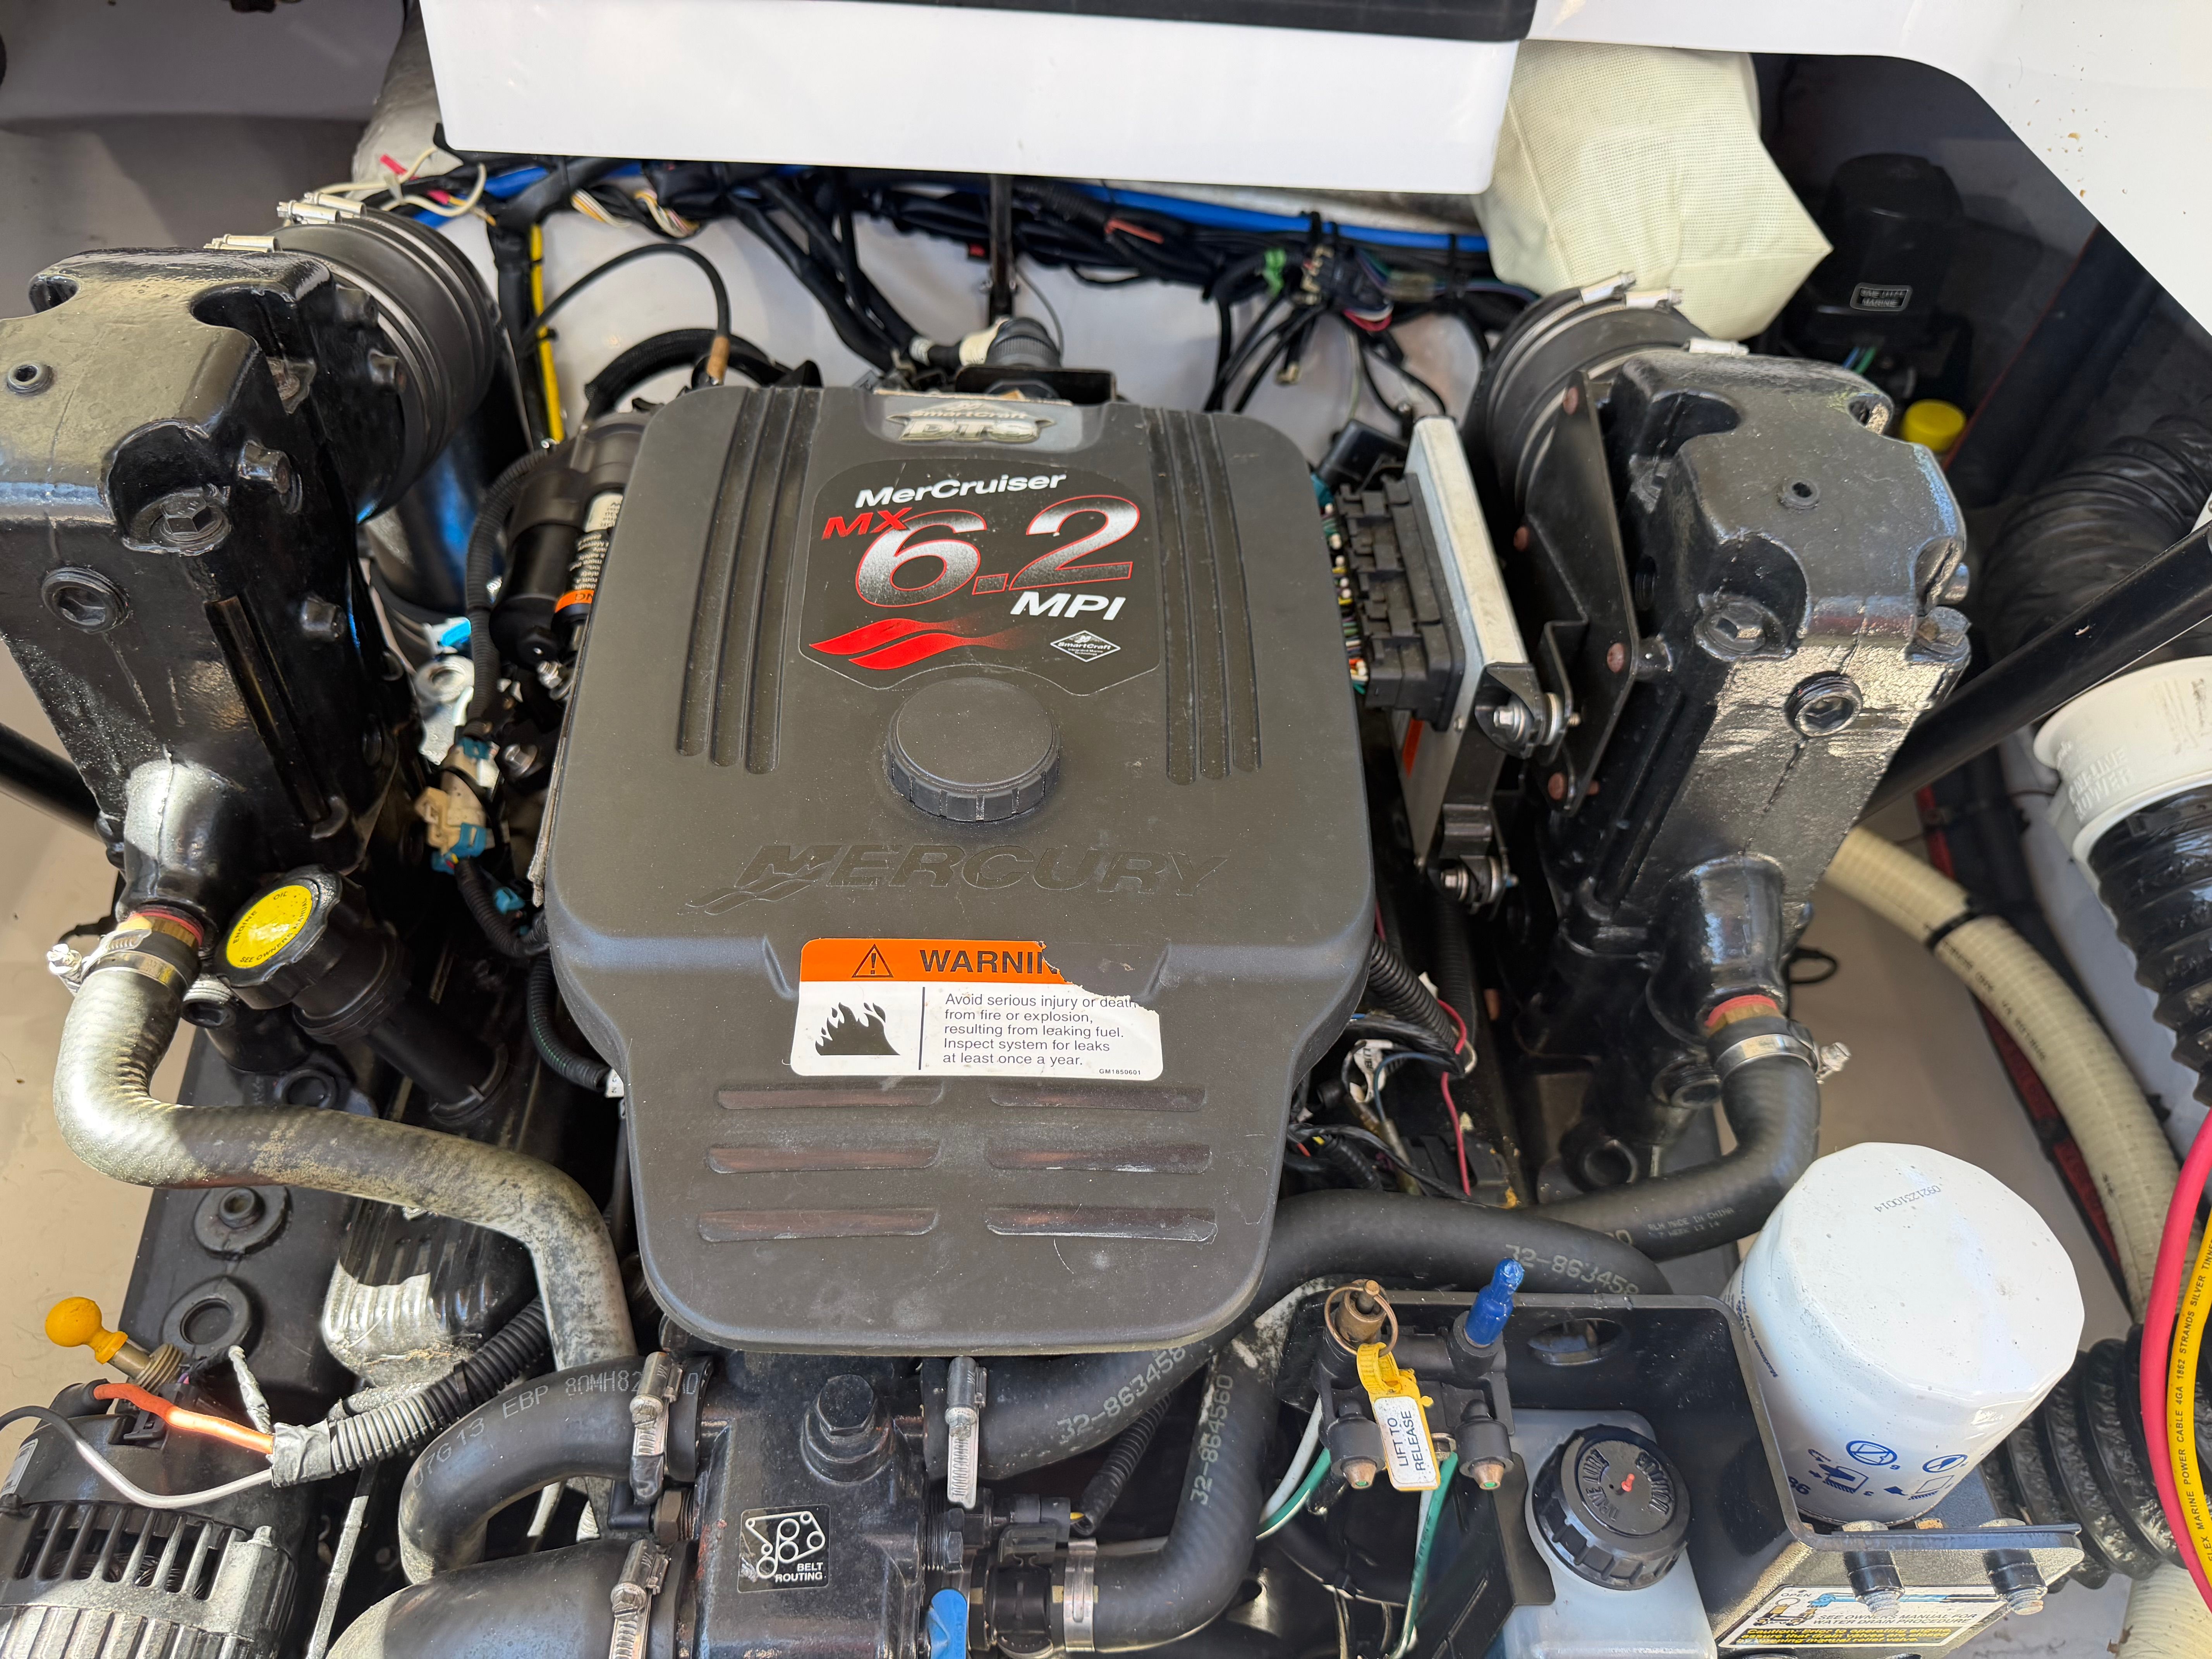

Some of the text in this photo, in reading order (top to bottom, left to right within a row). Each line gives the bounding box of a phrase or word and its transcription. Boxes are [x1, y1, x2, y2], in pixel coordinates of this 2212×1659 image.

[900, 419, 1039, 443] DTS
[854, 473, 1067, 508] MerCruiser
[821, 507, 912, 540] MX
[856, 495, 1140, 607] 6.2
[1010, 591, 1127, 620] MPI
[1058, 642, 1111, 650] SmartCraft
[735, 845, 1228, 896] MERCURY
[233, 891, 288, 945] ENGINE OIL
[256, 933, 294, 960] OWNERS
[292, 898, 308, 929] MANUAL
[945, 993, 982, 1005] Avoid
[987, 994, 1036, 1006] serious
[1041, 995, 1077, 1010] injury
[1082, 998, 1095, 1007] or
[945, 1009, 975, 1019] from
[980, 1010, 1001, 1020] fire
[1024, 1011, 1093, 1024] explosion,
[944, 1038, 1110, 1052] Inspect system for leaks
[945, 1024, 1123, 1039] resulting from leaking fuel.
[943, 1053, 1082, 1067] at least once a year.
[1667, 1218, 1690, 1227] MADE
[1693, 1214, 1704, 1223] IN
[1706, 1207, 1735, 1219] CHINA
[2190, 1275, 2206, 1307] SILVER
[2180, 1311, 2195, 1354] STRANDS
[2177, 1359, 2185, 1379] 1862
[1056, 1346, 1186, 1441] 32-863458
[2176, 1386, 2184, 1405] 4GA
[412, 1442, 452, 1489] 07G
[457, 1417, 485, 1446] 13
[502, 1384, 549, 1419] EBP
[1387, 1417, 1409, 1466] LIFT TO
[1401, 1410, 1425, 1470] RELEASE
[2176, 1410, 2185, 1443] CABLE
[1634, 1450, 1674, 1515] MONITOR
[2178, 1449, 2191, 1485] POWER
[1583, 1448, 1620, 1522] DRIVE LUBE
[2186, 1491, 2205, 1530] MARINE
[775, 1571, 823, 1583] ROUTING
[797, 1562, 823, 1572] BELT
